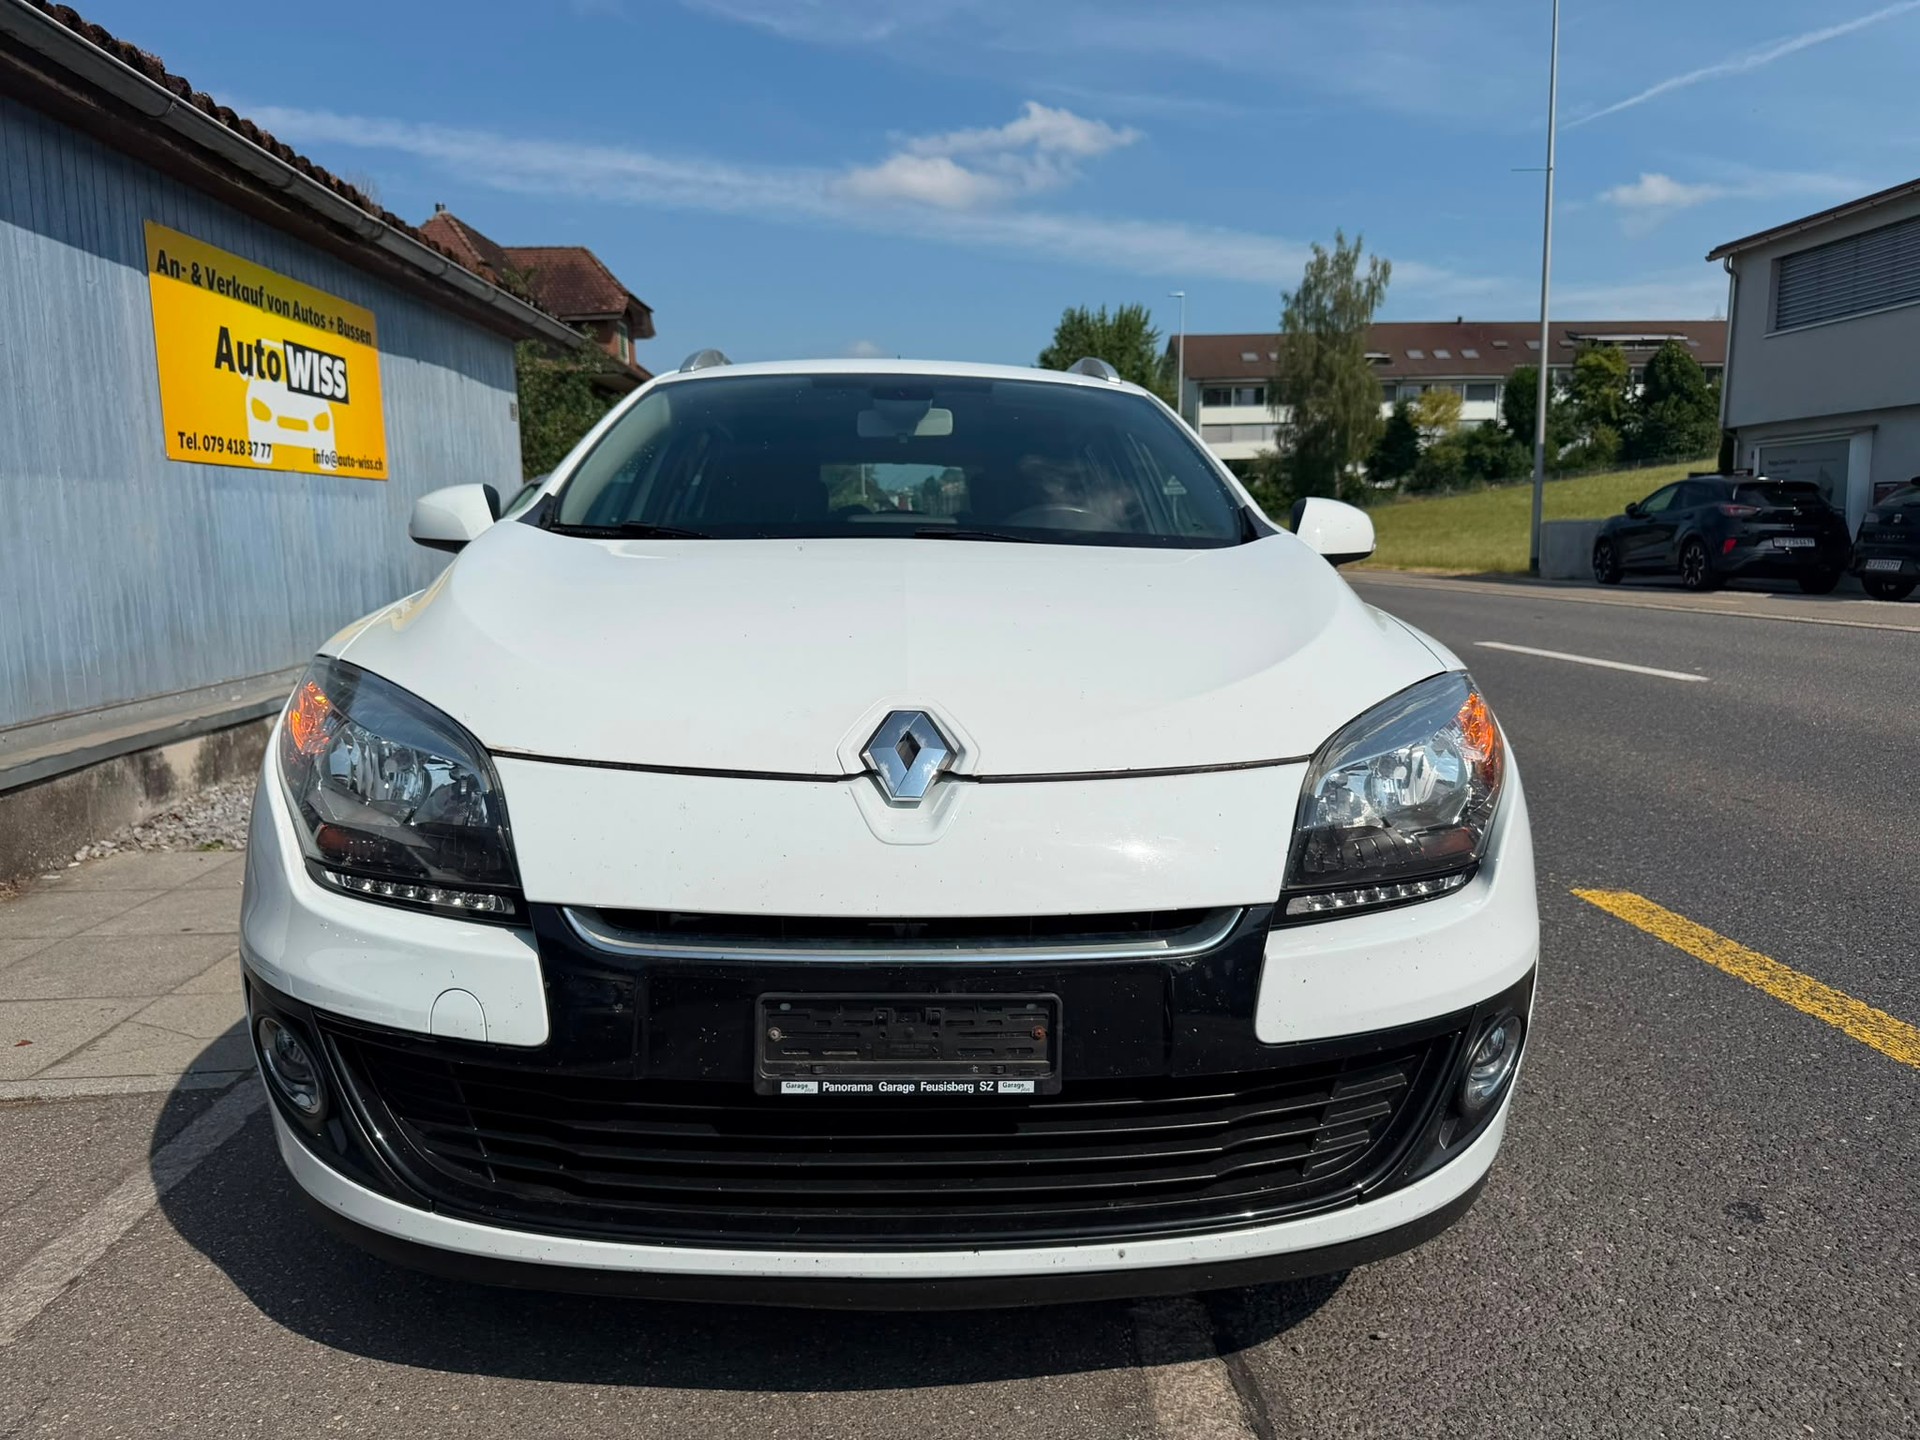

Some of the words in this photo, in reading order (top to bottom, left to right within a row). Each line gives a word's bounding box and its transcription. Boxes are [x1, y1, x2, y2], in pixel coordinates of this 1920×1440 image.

[156, 249, 187, 279] An-
[190, 262, 202, 286] &
[205, 266, 265, 306] Verkauf
[267, 294, 290, 317] von
[293, 301, 326, 329] Autos
[328, 318, 335, 329] +
[337, 316, 372, 345] Bussen
[178, 431, 201, 451] Tel.
[203, 434, 225, 453] 079
[226, 438, 246, 456] 418
[312, 448, 383, 471] info@auto-wiss.ch
[785, 1082, 808, 1090] Garage
[822, 1081, 874, 1092] Panorama
[878, 1081, 915, 1093] Garage
[920, 1081, 975, 1093] Feusisberg
[979, 1081, 994, 1091] SZ
